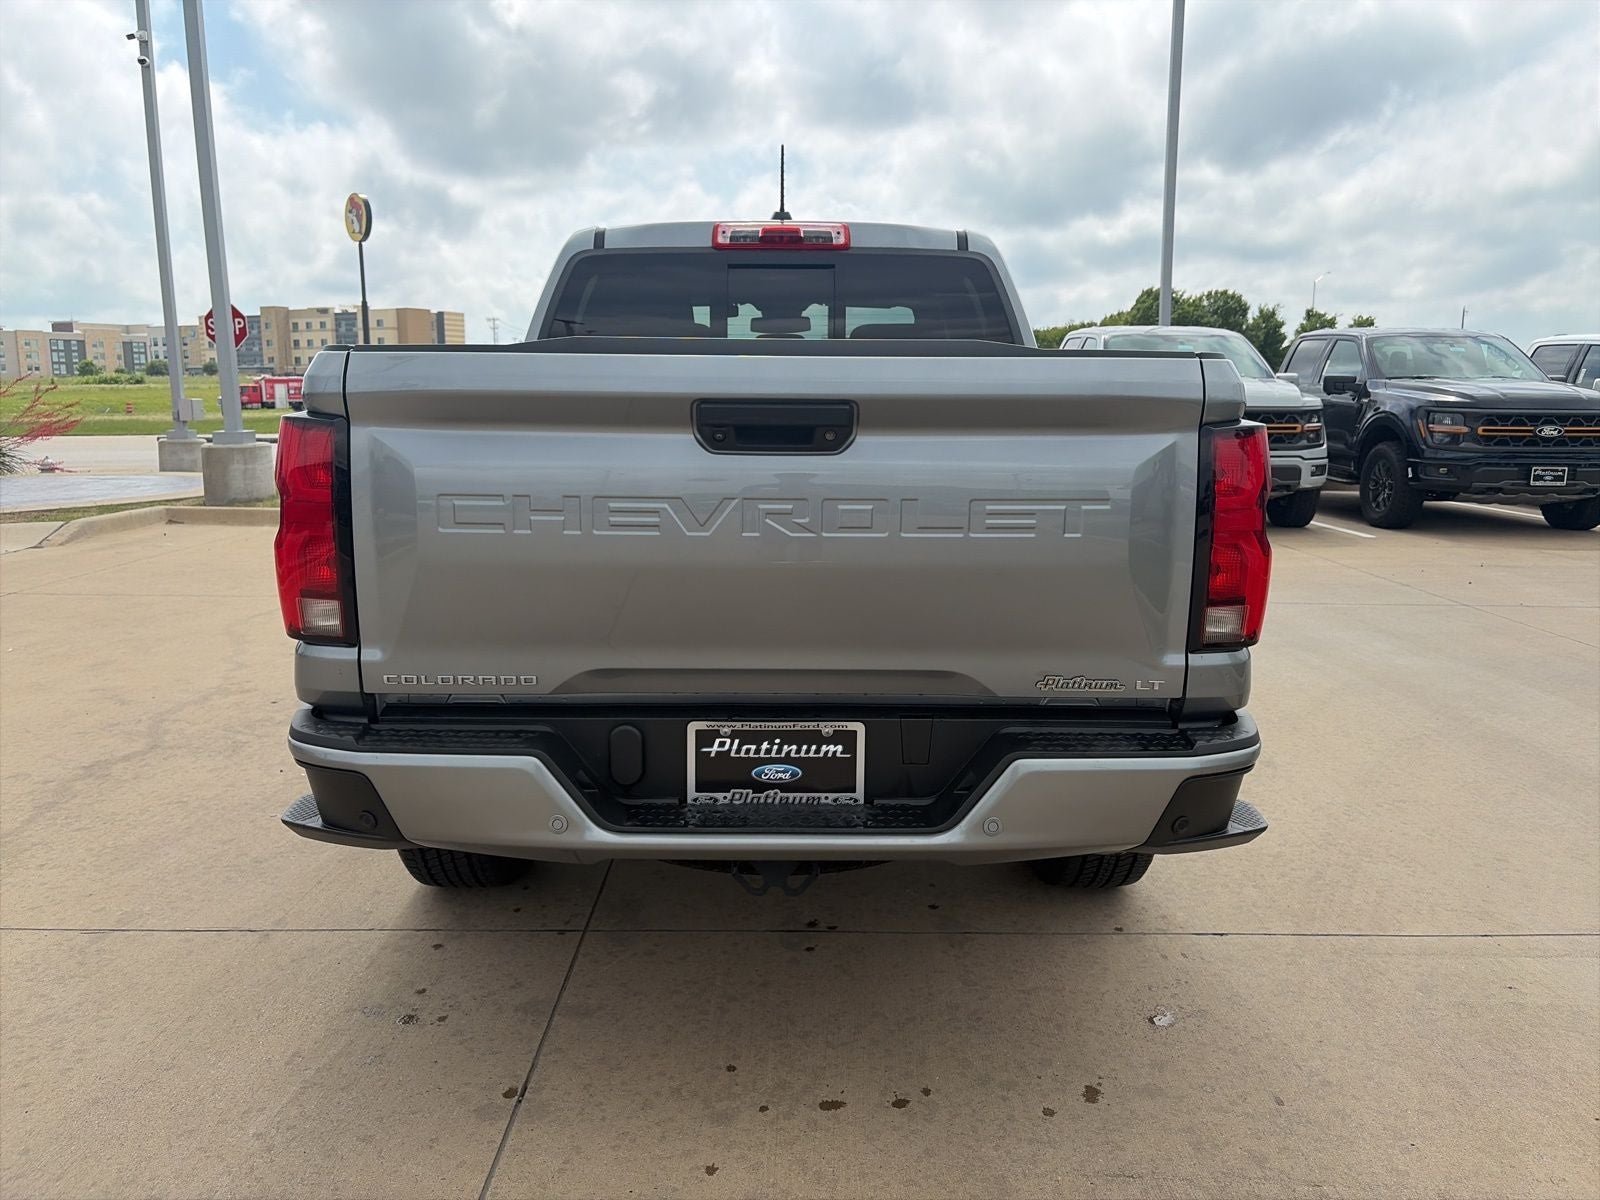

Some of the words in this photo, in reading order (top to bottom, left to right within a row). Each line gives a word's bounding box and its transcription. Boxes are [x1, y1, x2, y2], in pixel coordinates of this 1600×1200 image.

[208, 318, 244, 335] SP
[1541, 426, 1559, 435] Ford
[437, 494, 1111, 538] CHEVROLET
[383, 674, 537, 686] COLORADO
[1036, 675, 1126, 692] Platinum
[1136, 680, 1165, 690] LT
[700, 738, 852, 758] Platinum
[761, 766, 792, 780] Ford
[730, 789, 821, 804] Platinum
